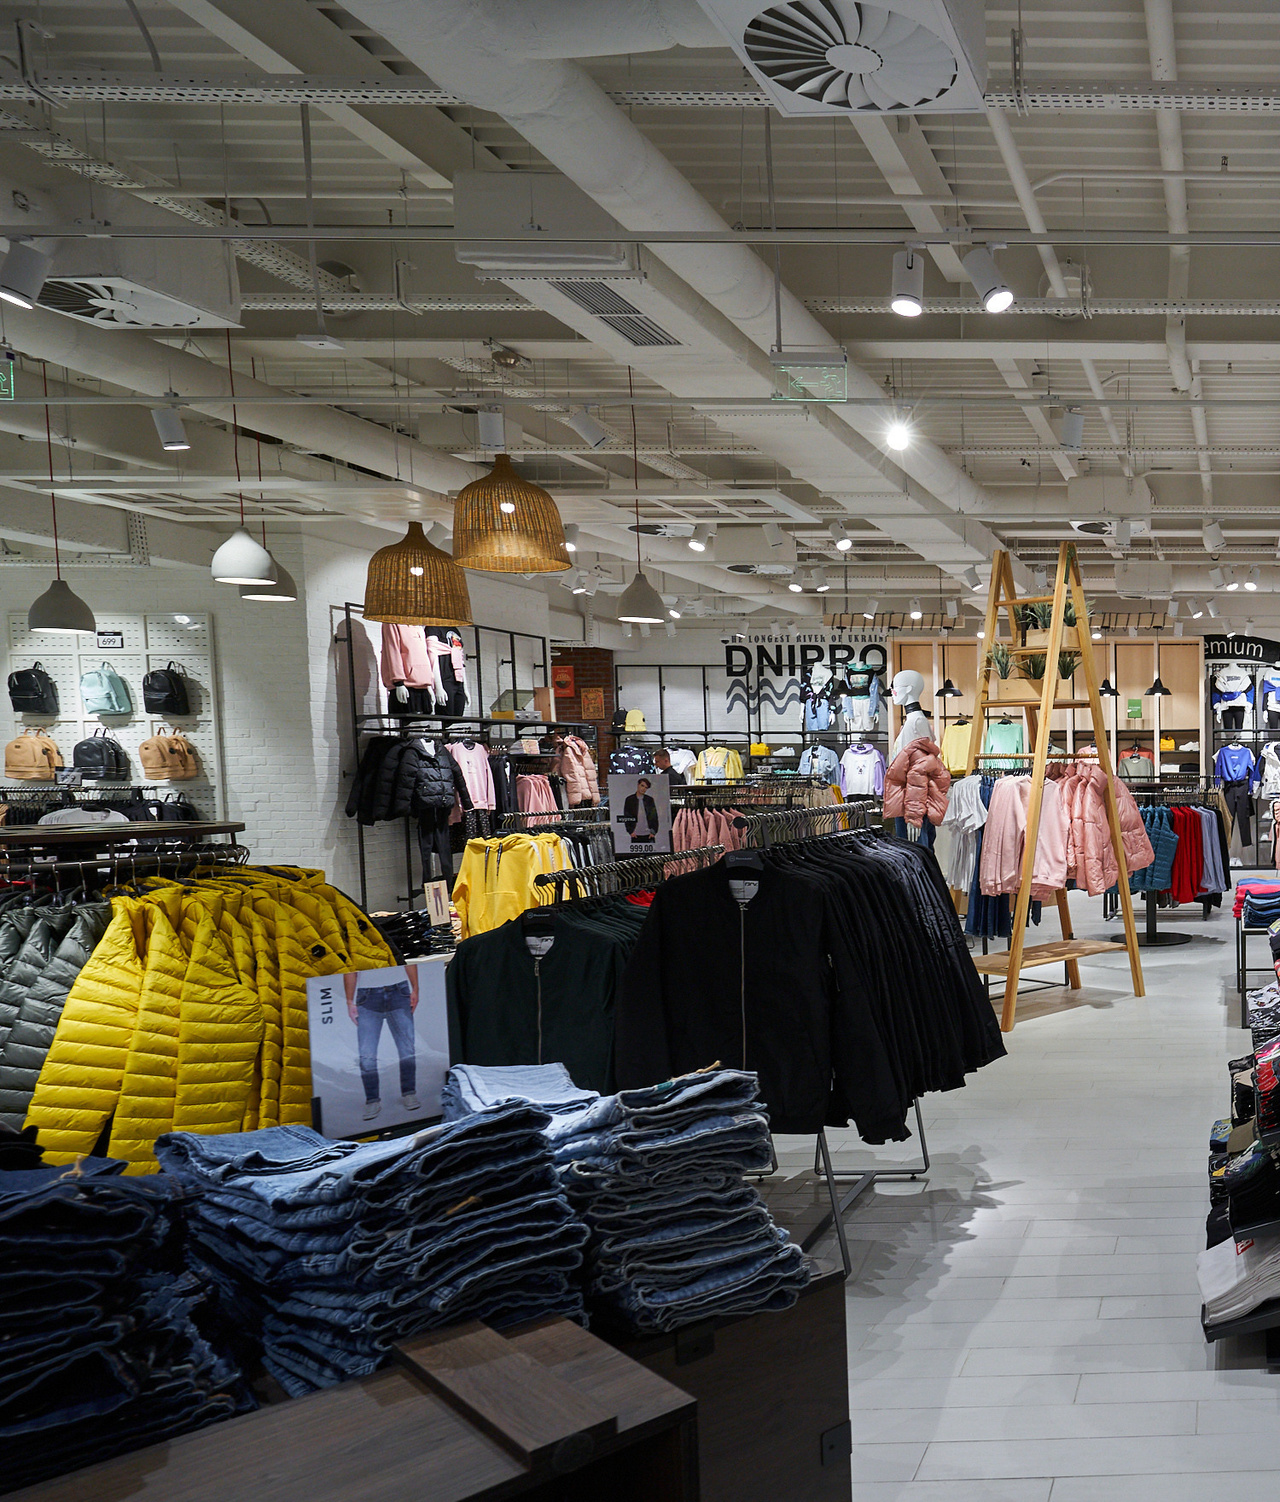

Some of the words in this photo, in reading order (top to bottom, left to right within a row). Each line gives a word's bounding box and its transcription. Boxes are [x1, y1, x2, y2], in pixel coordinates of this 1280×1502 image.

[748, 634, 791, 643] LONGEST
[796, 634, 826, 643] RIVER
[831, 634, 842, 643] OF
[725, 643, 888, 677] DNIPRO
[629, 844, 654, 853] 999.00
[319, 987, 334, 1025] SLIM
